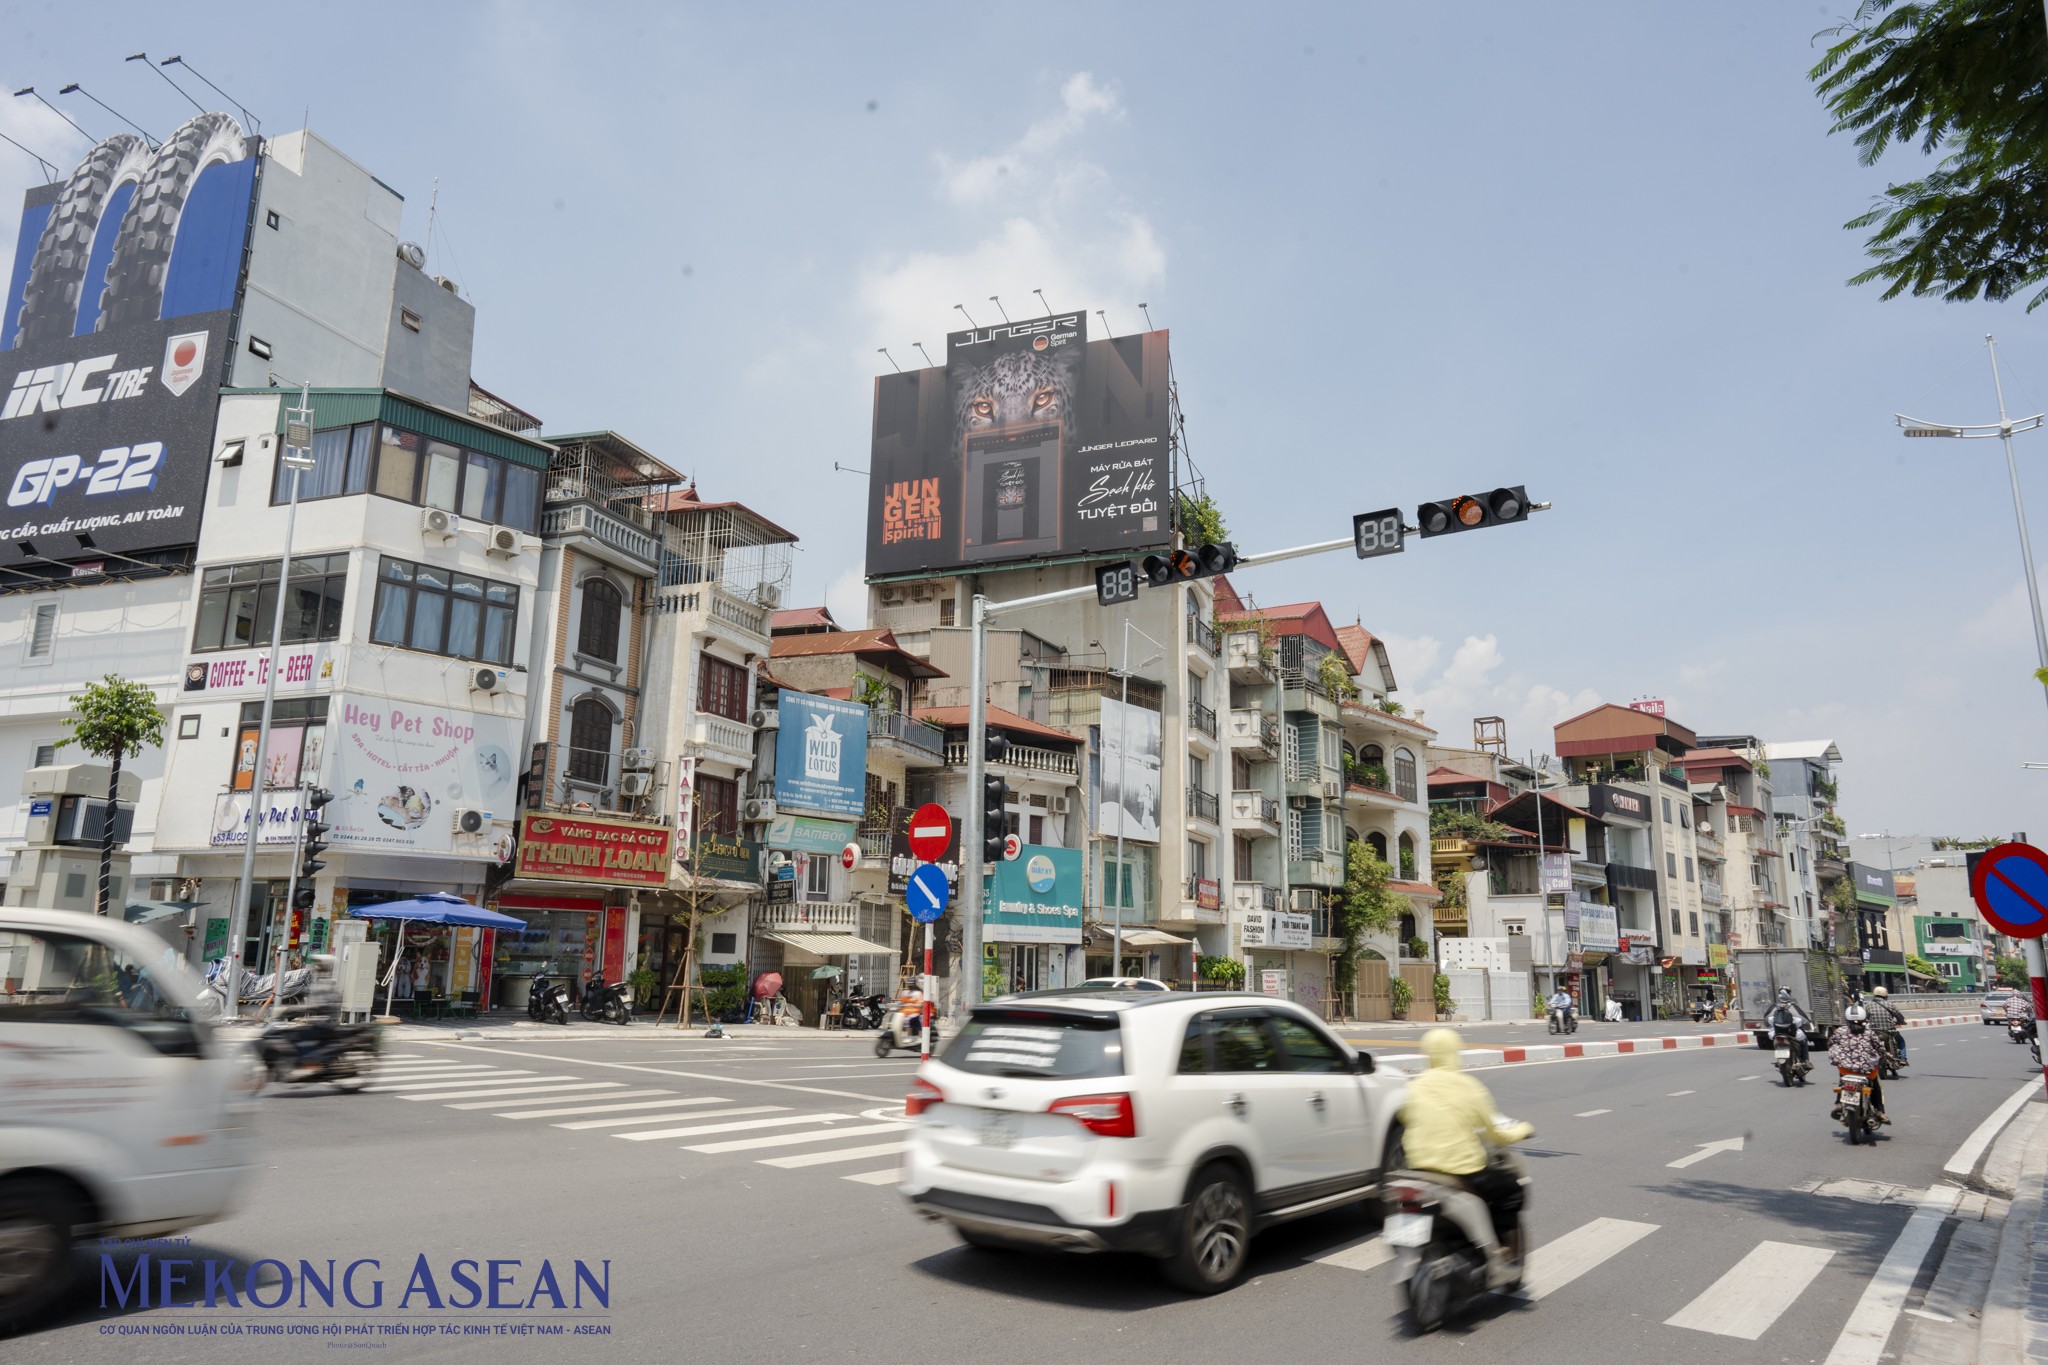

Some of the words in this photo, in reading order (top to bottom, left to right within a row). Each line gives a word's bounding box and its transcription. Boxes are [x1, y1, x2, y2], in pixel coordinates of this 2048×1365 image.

[956, 315, 1078, 347] JUNGER
[1050, 331, 1078, 342] German
[1050, 338, 1067, 347] Spirit
[0, 353, 118, 421] IRC
[101, 366, 154, 402] TIRE
[1078, 443, 1113, 453] JUNGER
[1114, 437, 1158, 448] LEOPARD
[7, 441, 165, 508] GP-22
[1090, 463, 1111, 473] MÁY
[1112, 460, 1133, 471] RỬA
[1133, 457, 1154, 468] BÁT
[1077, 471, 1134, 507] Sạch
[1131, 468, 1157, 499] khô
[1077, 503, 1128, 520] TUYỆT
[11, 522, 38, 538] CẤP,
[40, 518, 74, 534] CHẤT
[75, 514, 121, 532] LƯỢNG,
[123, 511, 144, 524] AN
[148, 505, 185, 520] TOÀN
[886, 525, 924, 544] spirit
[209, 660, 247, 688] COFFEE
[256, 658, 270, 685] TE
[286, 655, 313, 683] BEER
[1639, 702, 1664, 714] Nails
[344, 703, 381, 732] Hey
[391, 710, 422, 734] Pet
[432, 716, 474, 744] Shop
[351, 733, 364, 748] SPA
[366, 750, 391, 769] HOTEL
[397, 763, 413, 773] CẮT
[434, 746, 459, 767] NHUỘM
[809, 739, 838, 759] WILD
[808, 757, 837, 774] LOTUS
[269, 807, 288, 823] Pet
[676, 759, 691, 859] TATTOO
[560, 823, 593, 839] VÀNG
[595, 830, 619, 845] BẠC
[620, 830, 636, 844] ĐÁ
[794, 827, 847, 842] BAMBOO
[603, 847, 669, 873] LOAN
[1028, 903, 1036, 914] &
[1036, 903, 1061, 915] Shoes
[1062, 905, 1079, 918] Spa
[1246, 914, 1262, 923] DAVID
[1243, 924, 1265, 934] FASHION
